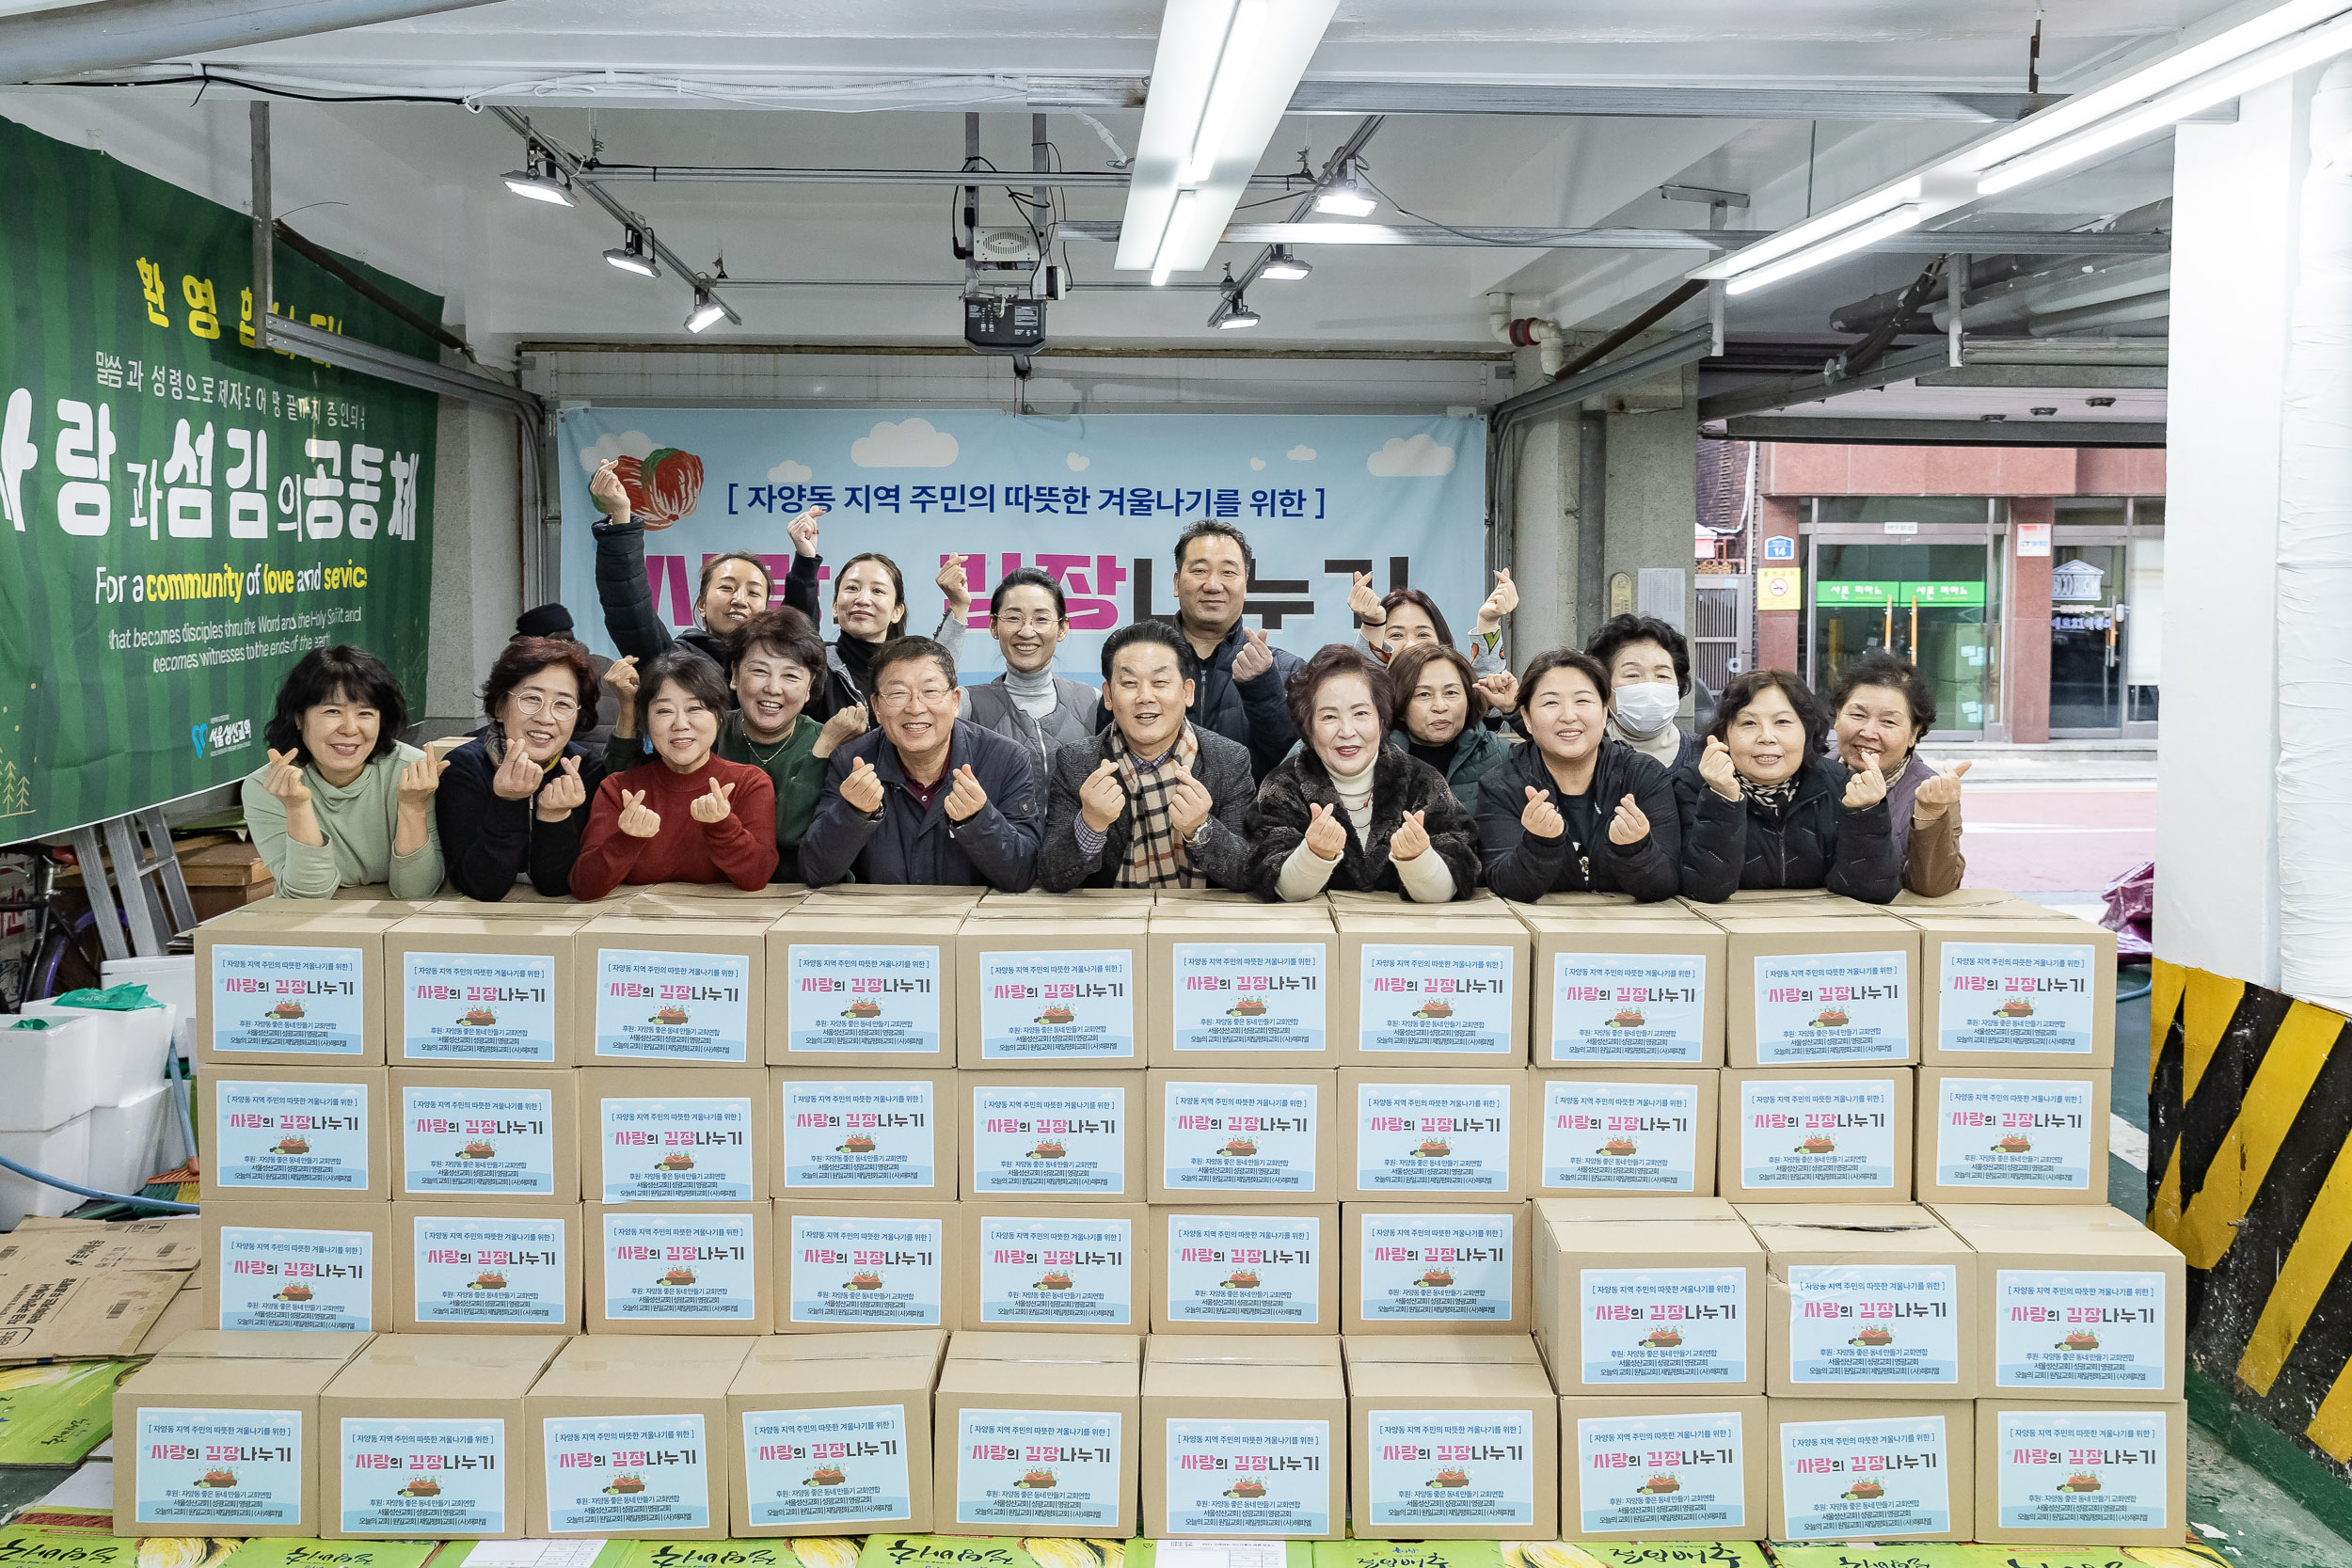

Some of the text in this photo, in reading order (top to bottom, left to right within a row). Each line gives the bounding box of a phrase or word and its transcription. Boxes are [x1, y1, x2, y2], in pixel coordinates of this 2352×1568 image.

[151, 365, 215, 404] 성령으로
[844, 484, 900, 515] 지역
[909, 484, 995, 515] 주민의
[1005, 484, 1090, 515] 따뜻한
[1098, 486, 1242, 517] 겨울나기를
[1249, 487, 1306, 518] 위한
[1773, 546, 1787, 557] 14
[95, 566, 128, 604] For
[133, 575, 145, 603] a
[147, 563, 244, 604] community
[246, 563, 262, 597] of
[263, 563, 294, 595] love
[134, 625, 182, 649] becomes
[183, 621, 224, 644] disciples
[259, 614, 280, 633] Word
[153, 652, 199, 673] becomes
[200, 645, 246, 667] witnesses
[300, 634, 313, 650] the
[226, 977, 353, 995] 사랑의 김장나누기
[993, 983, 1122, 999] 사랑의 김장나누기
[1186, 975, 1315, 990] 사랑의 김장나누기
[1954, 975, 2084, 992] 사랑의 김장나누기
[610, 982, 738, 1002] 사랑의 김장나누기
[1566, 986, 1694, 1002] 사랑의 김장나누기
[230, 1113, 358, 1131] 사랑의 김장나누기
[797, 1113, 924, 1127] 사랑의 김장나누기
[1177, 1115, 1306, 1132] 사랑의 김장나누기
[1557, 1115, 1687, 1132] 사랑의 김장나누기
[1952, 1111, 2081, 1128] 사랑의 김장나누기
[427, 1249, 555, 1265] 사랑의 김장나누기
[993, 1249, 1121, 1265] 사랑의 김장나누기
[1375, 1246, 1502, 1261] 사랑의 김장나누기
[2013, 1286, 2148, 1296] 자양동 지역 주민의 따뜻한 겨울나기를 위한
[1596, 1304, 1736, 1320] 사랑의 김장나누기
[1804, 1302, 1946, 1317] 사랑의 김장나누기
[2011, 1306, 2153, 1323] 사랑의 김장나누기
[153, 1424, 285, 1435] 자양동 지역 주민의 따뜻한 겨울나기를 위한
[151, 1444, 291, 1462] 사랑의 김장나누기
[758, 1440, 897, 1461] 사랑의 김장나누기
[1593, 1449, 1732, 1468] 사랑의 김장나누기
[1181, 1454, 1319, 1471] 사랑의 김장나누기
